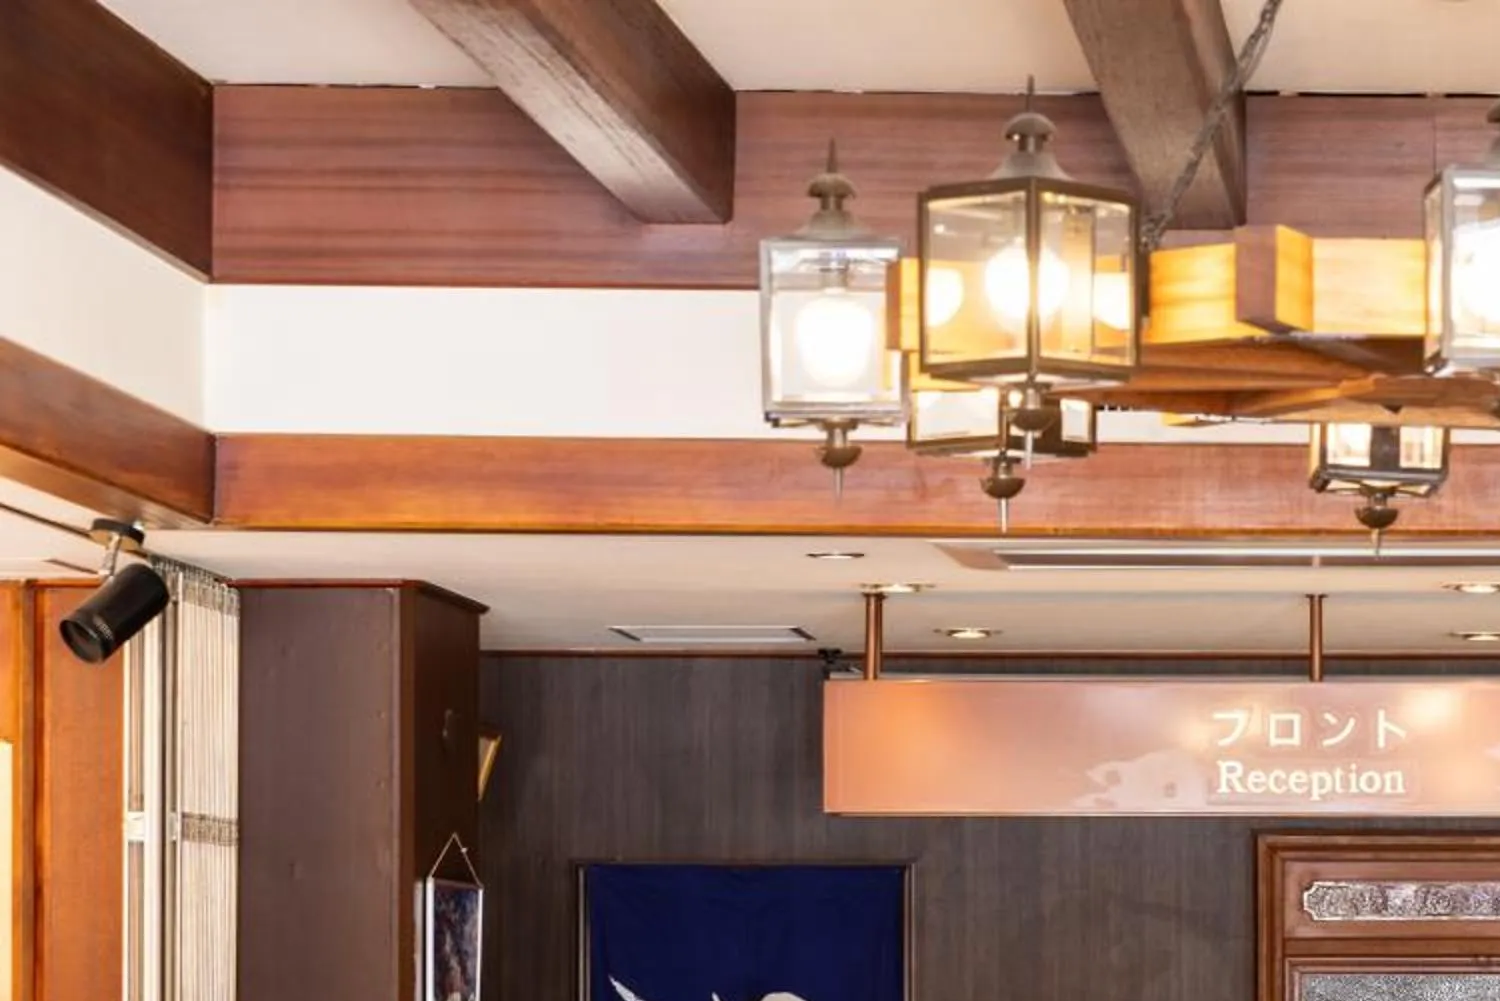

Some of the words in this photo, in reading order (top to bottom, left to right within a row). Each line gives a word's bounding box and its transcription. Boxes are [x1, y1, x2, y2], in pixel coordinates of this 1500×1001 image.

[1211, 708, 1407, 748] フロント
[1216, 760, 1405, 801] Reception
